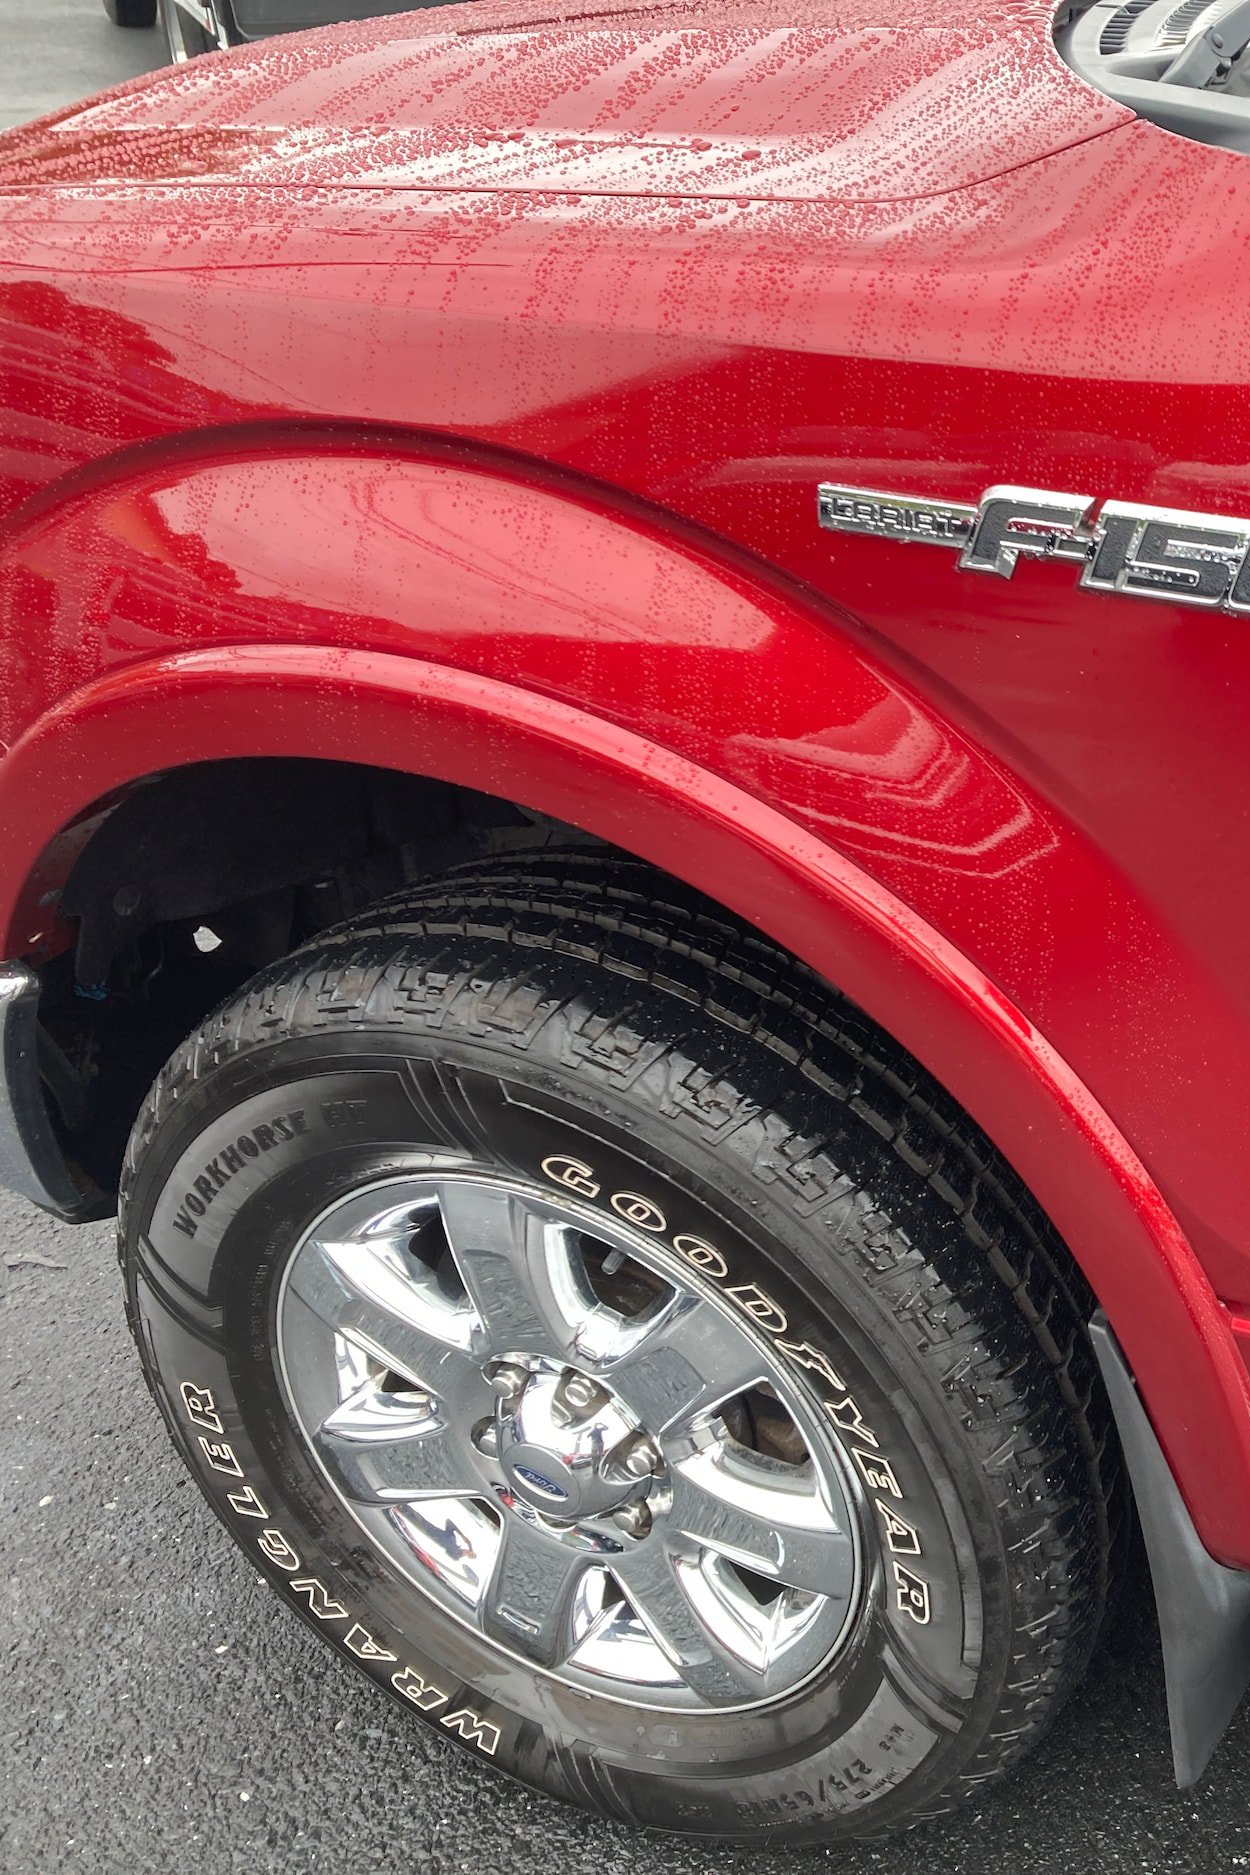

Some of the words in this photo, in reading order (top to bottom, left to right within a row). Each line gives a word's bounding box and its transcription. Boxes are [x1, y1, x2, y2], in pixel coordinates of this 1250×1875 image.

[828, 495, 965, 540] LARIAT
[172, 1107, 312, 1239] WORKHORSE
[541, 1153, 930, 1626] GOODYEAR
[180, 1381, 501, 1756] WRANGLER
